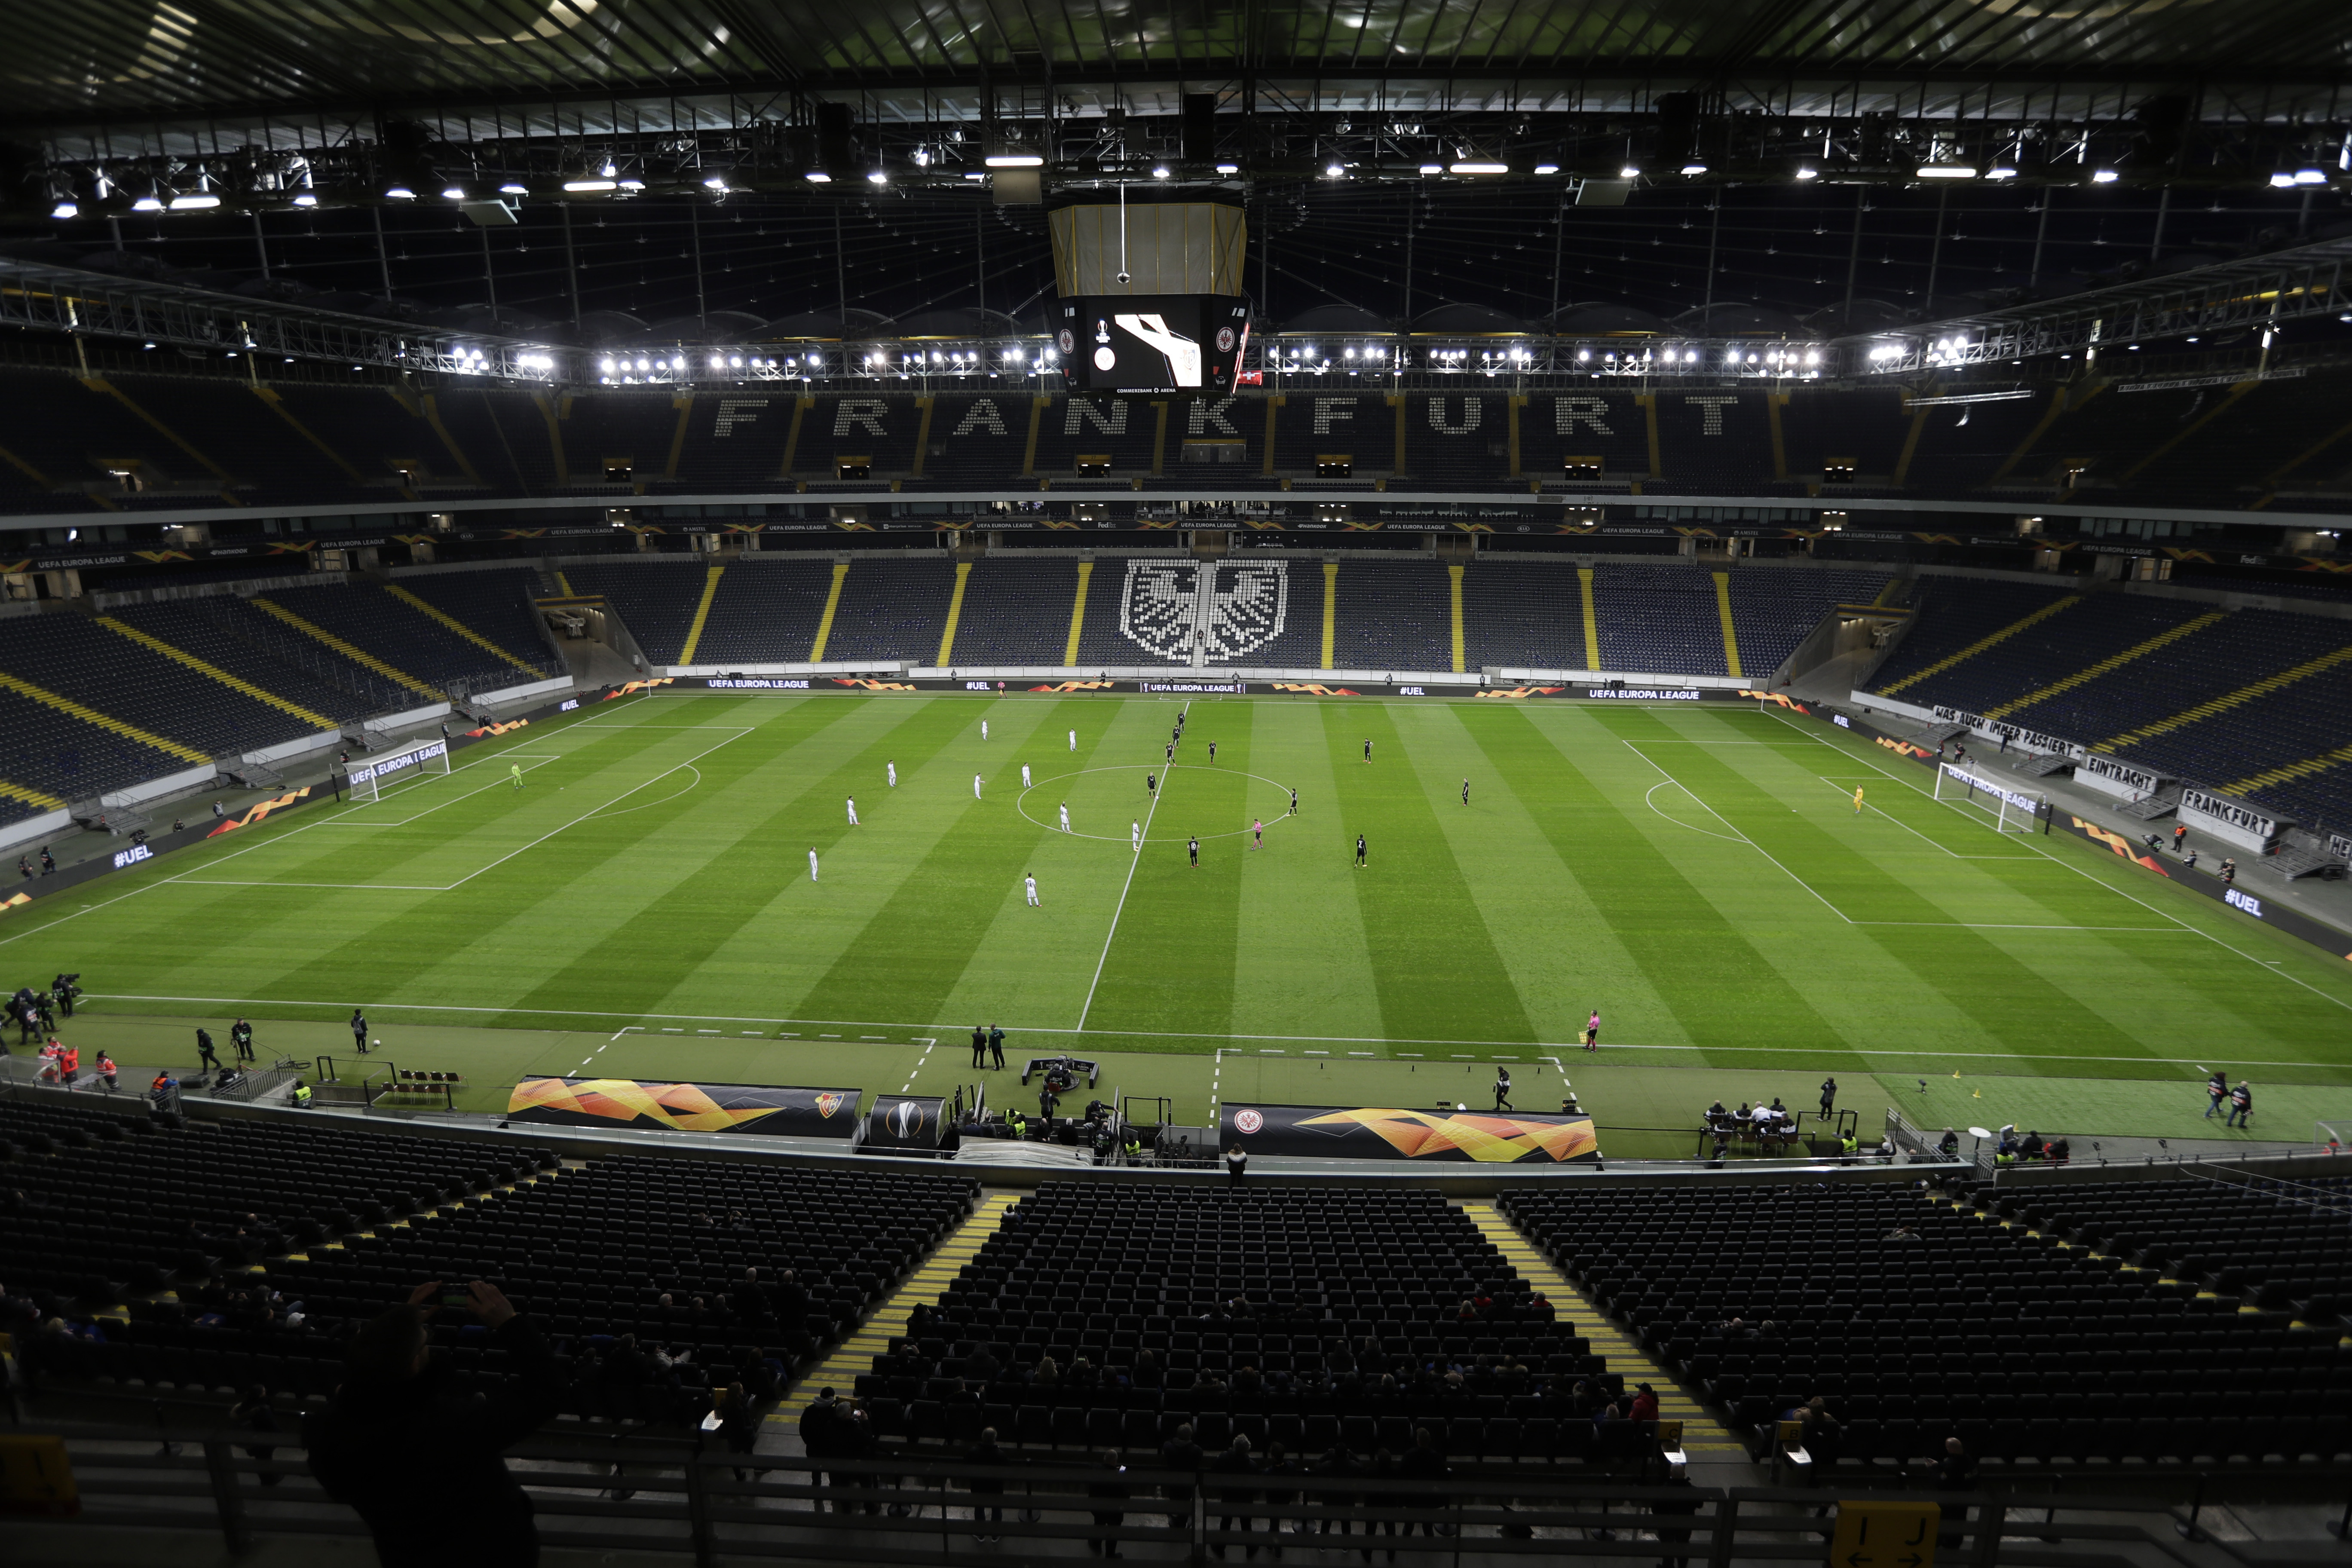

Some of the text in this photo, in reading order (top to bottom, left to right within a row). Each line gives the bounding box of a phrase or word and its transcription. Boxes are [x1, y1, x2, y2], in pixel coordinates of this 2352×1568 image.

[38, 560, 61, 569] UEFA
[62, 558, 94, 567] EUROPA
[708, 679, 809, 689] UEFA EUROPA LEAGUE
[966, 681, 990, 690] #UEL
[1400, 687, 1424, 696] #UEL
[1589, 689, 1699, 700] UEFA EUROPA LEAGUE
[561, 699, 579, 711] #UEL
[1833, 714, 1849, 728] #UEL
[1935, 707, 1955, 721] WAS
[1959, 713, 1985, 729] AUCH
[1989, 721, 2021, 741] IMMER
[2023, 731, 2074, 756] PASSIERT
[351, 767, 377, 784] UEFA
[378, 756, 414, 775] EUROPA
[2089, 757, 2152, 790] EINTRACHT
[2184, 790, 2269, 835] FRANKFURT
[115, 845, 153, 867] #UEL
[2332, 836, 2352, 858] HE
[2225, 888, 2263, 917] #UEL
[1668, 1429, 1678, 1438] C
[1789, 1429, 1798, 1438] B
[1859, 1517, 1868, 1545] I
[1905, 1518, 1926, 1546] J
